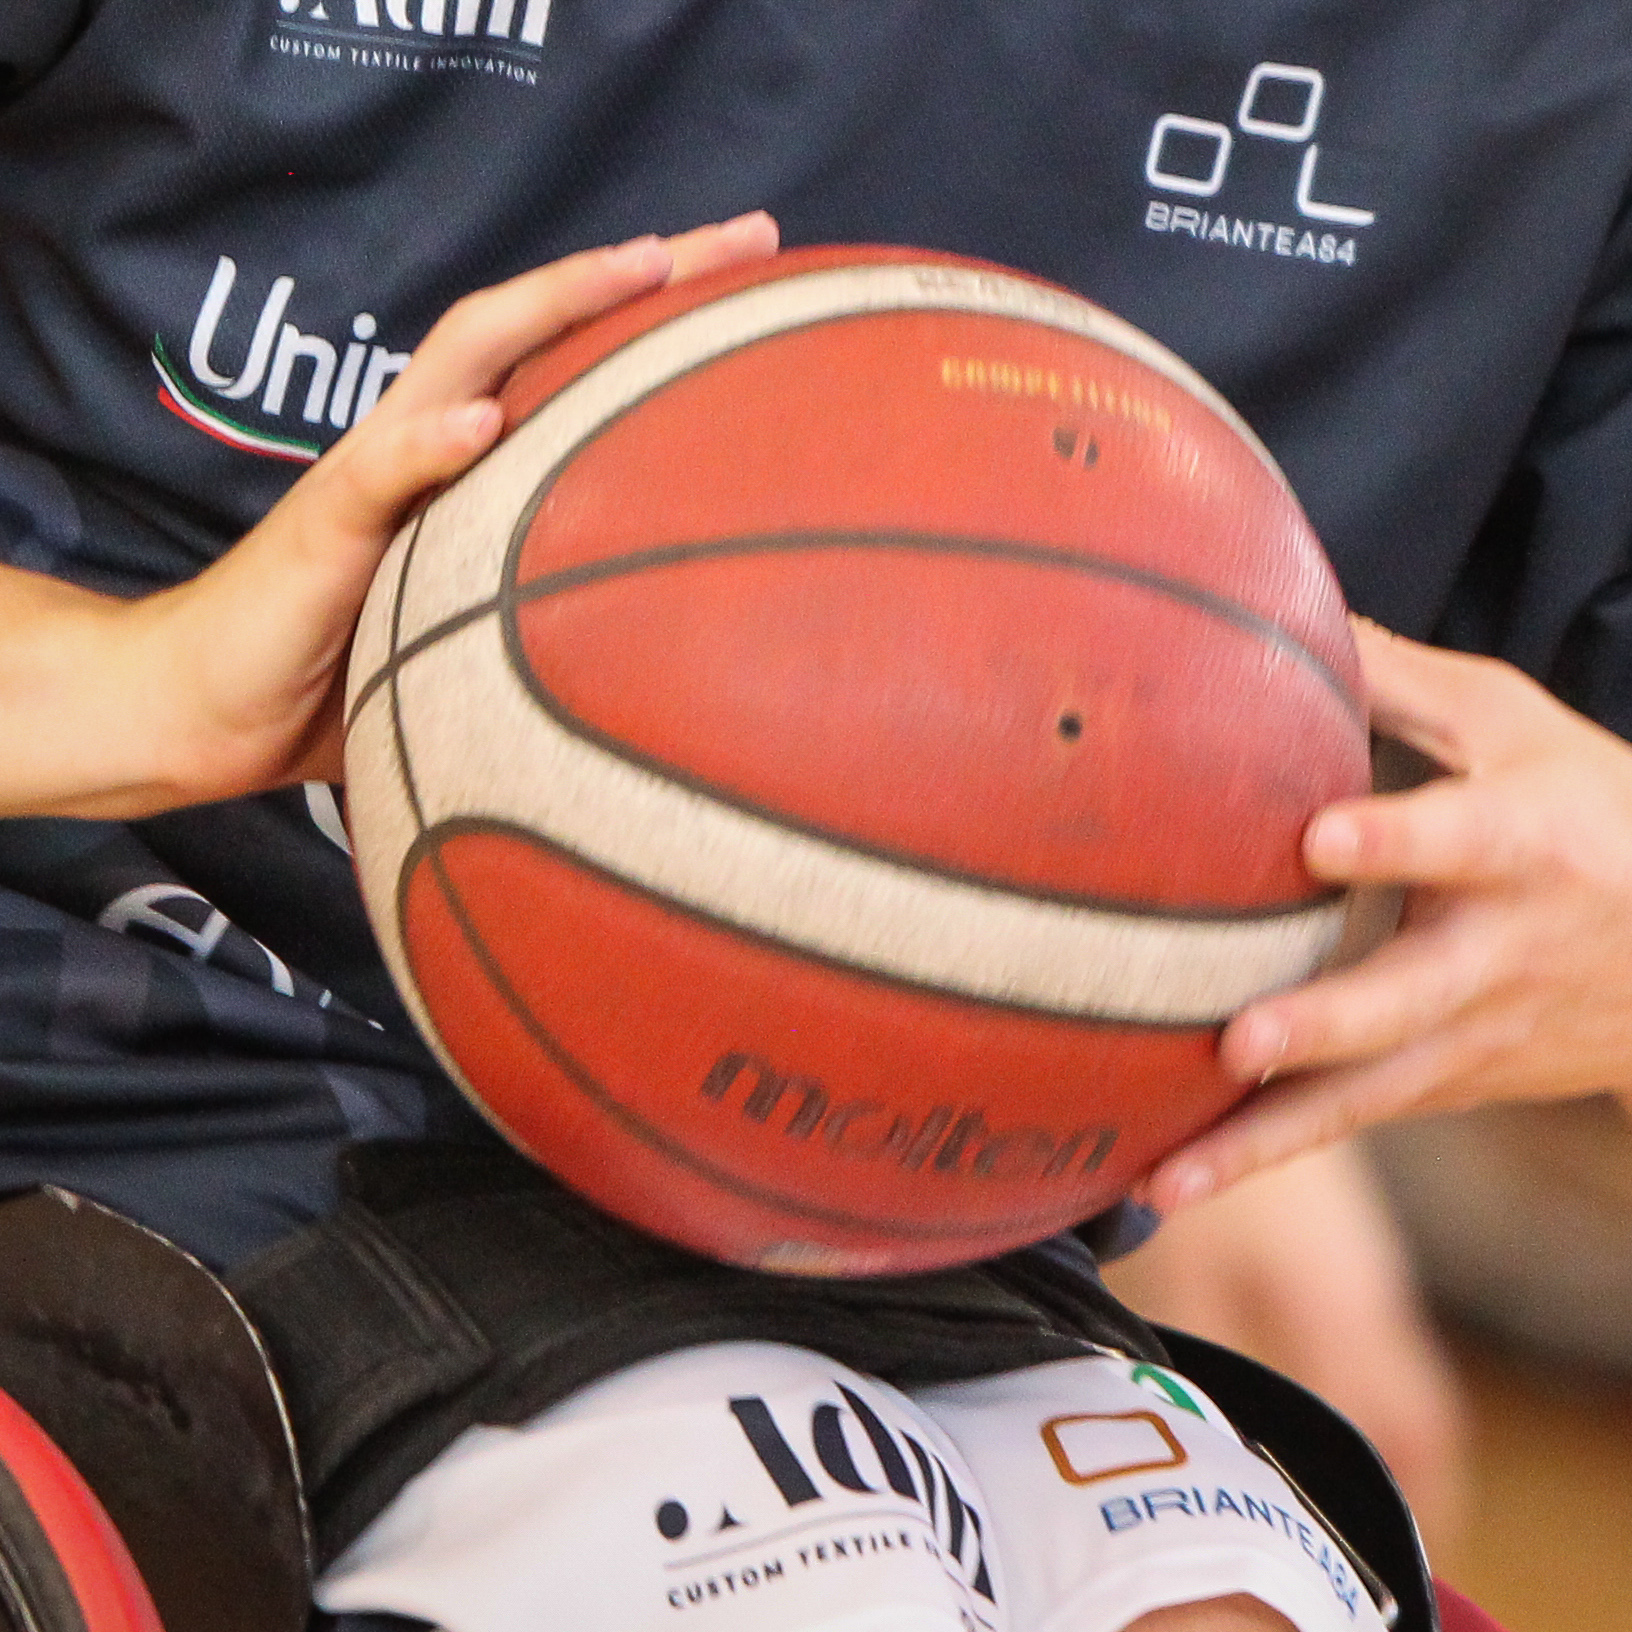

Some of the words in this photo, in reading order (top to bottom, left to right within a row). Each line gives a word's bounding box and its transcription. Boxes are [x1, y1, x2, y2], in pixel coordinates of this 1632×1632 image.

[270, 34, 342, 61] CUSTOM
[352, 47, 421, 72] TEXTILE
[430, 53, 538, 86] INNOVATION
[1144, 200, 1358, 267] BRIANTEA84
[700, 1051, 1120, 1177] molten
[667, 1557, 785, 1610] CUSTOM
[796, 1530, 913, 1569] TEXTILE
